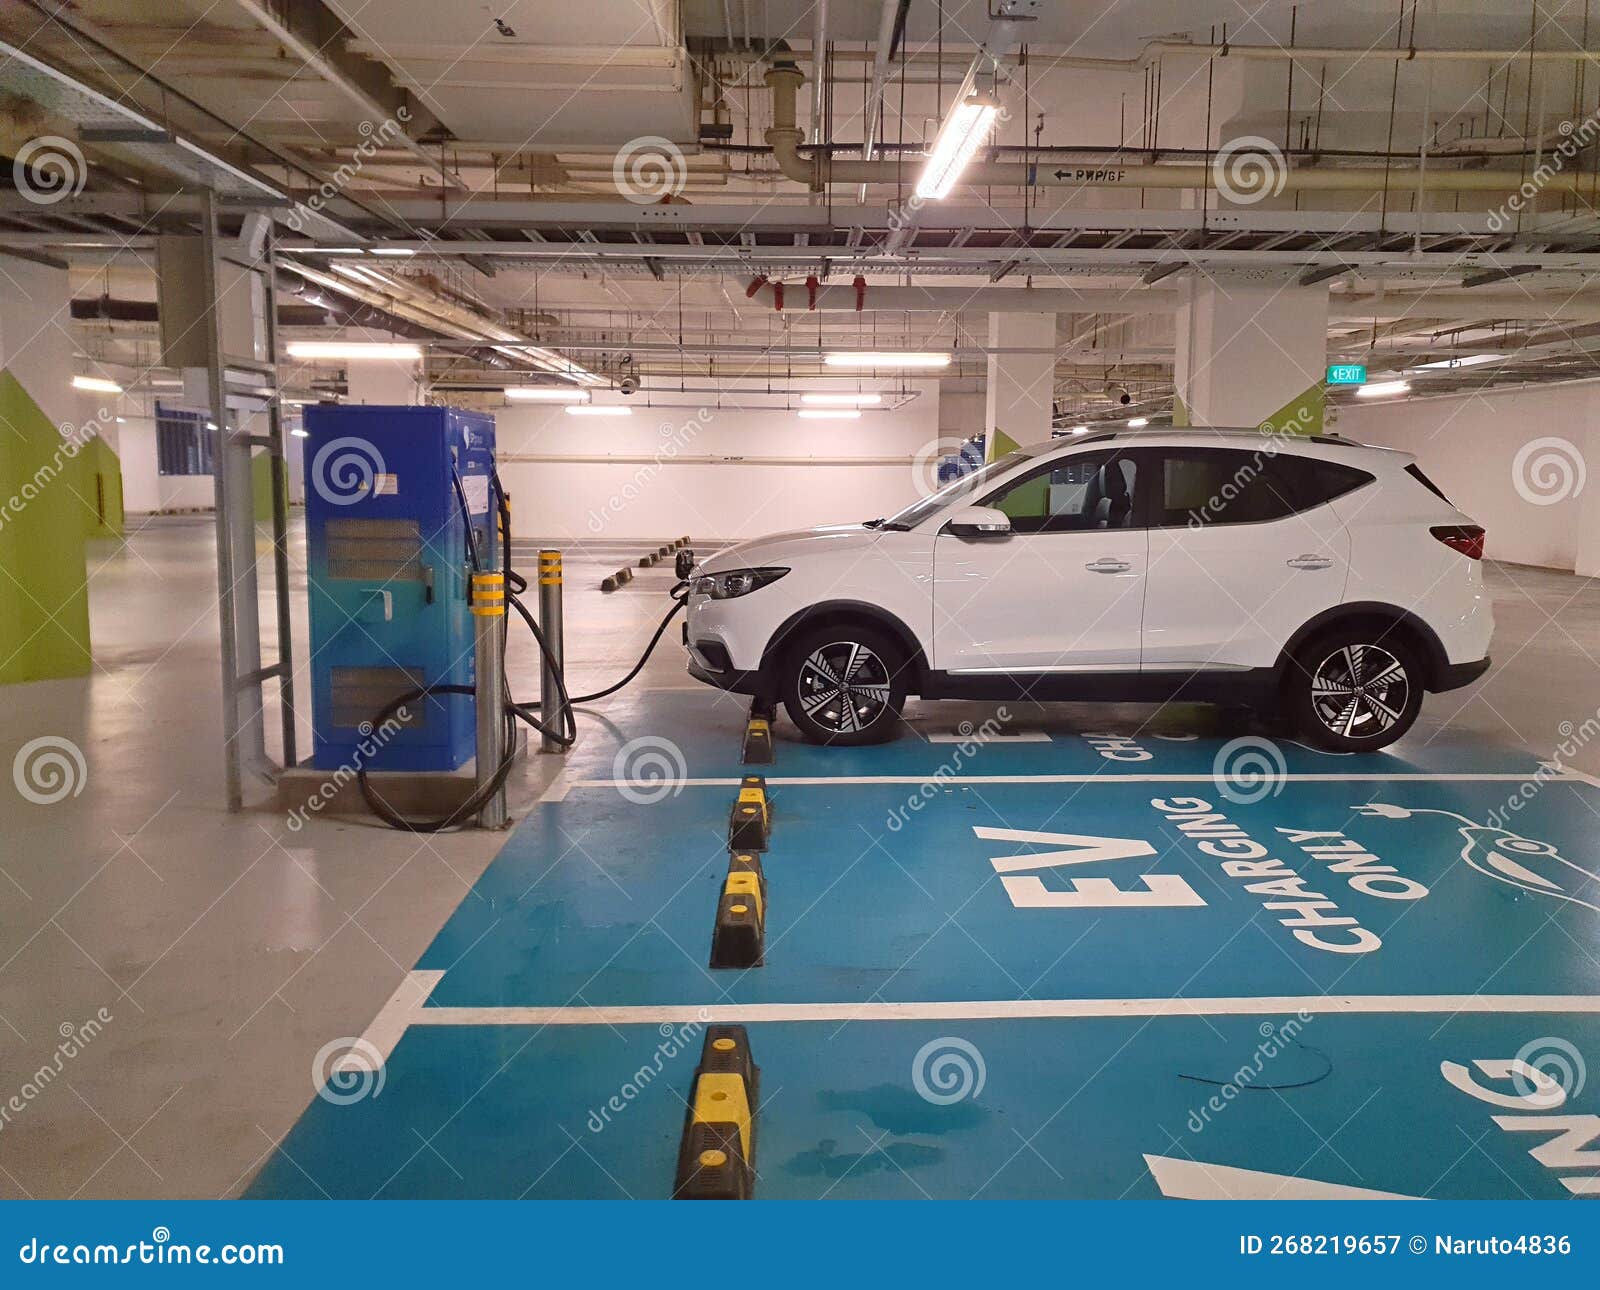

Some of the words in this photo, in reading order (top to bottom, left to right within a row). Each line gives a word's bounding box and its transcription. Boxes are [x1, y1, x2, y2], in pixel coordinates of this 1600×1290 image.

[1338, 368, 1361, 380] EXIT
[972, 826, 1208, 908] EV
[1150, 797, 1382, 954] CHARGING
[1275, 826, 1430, 900] ONLY
